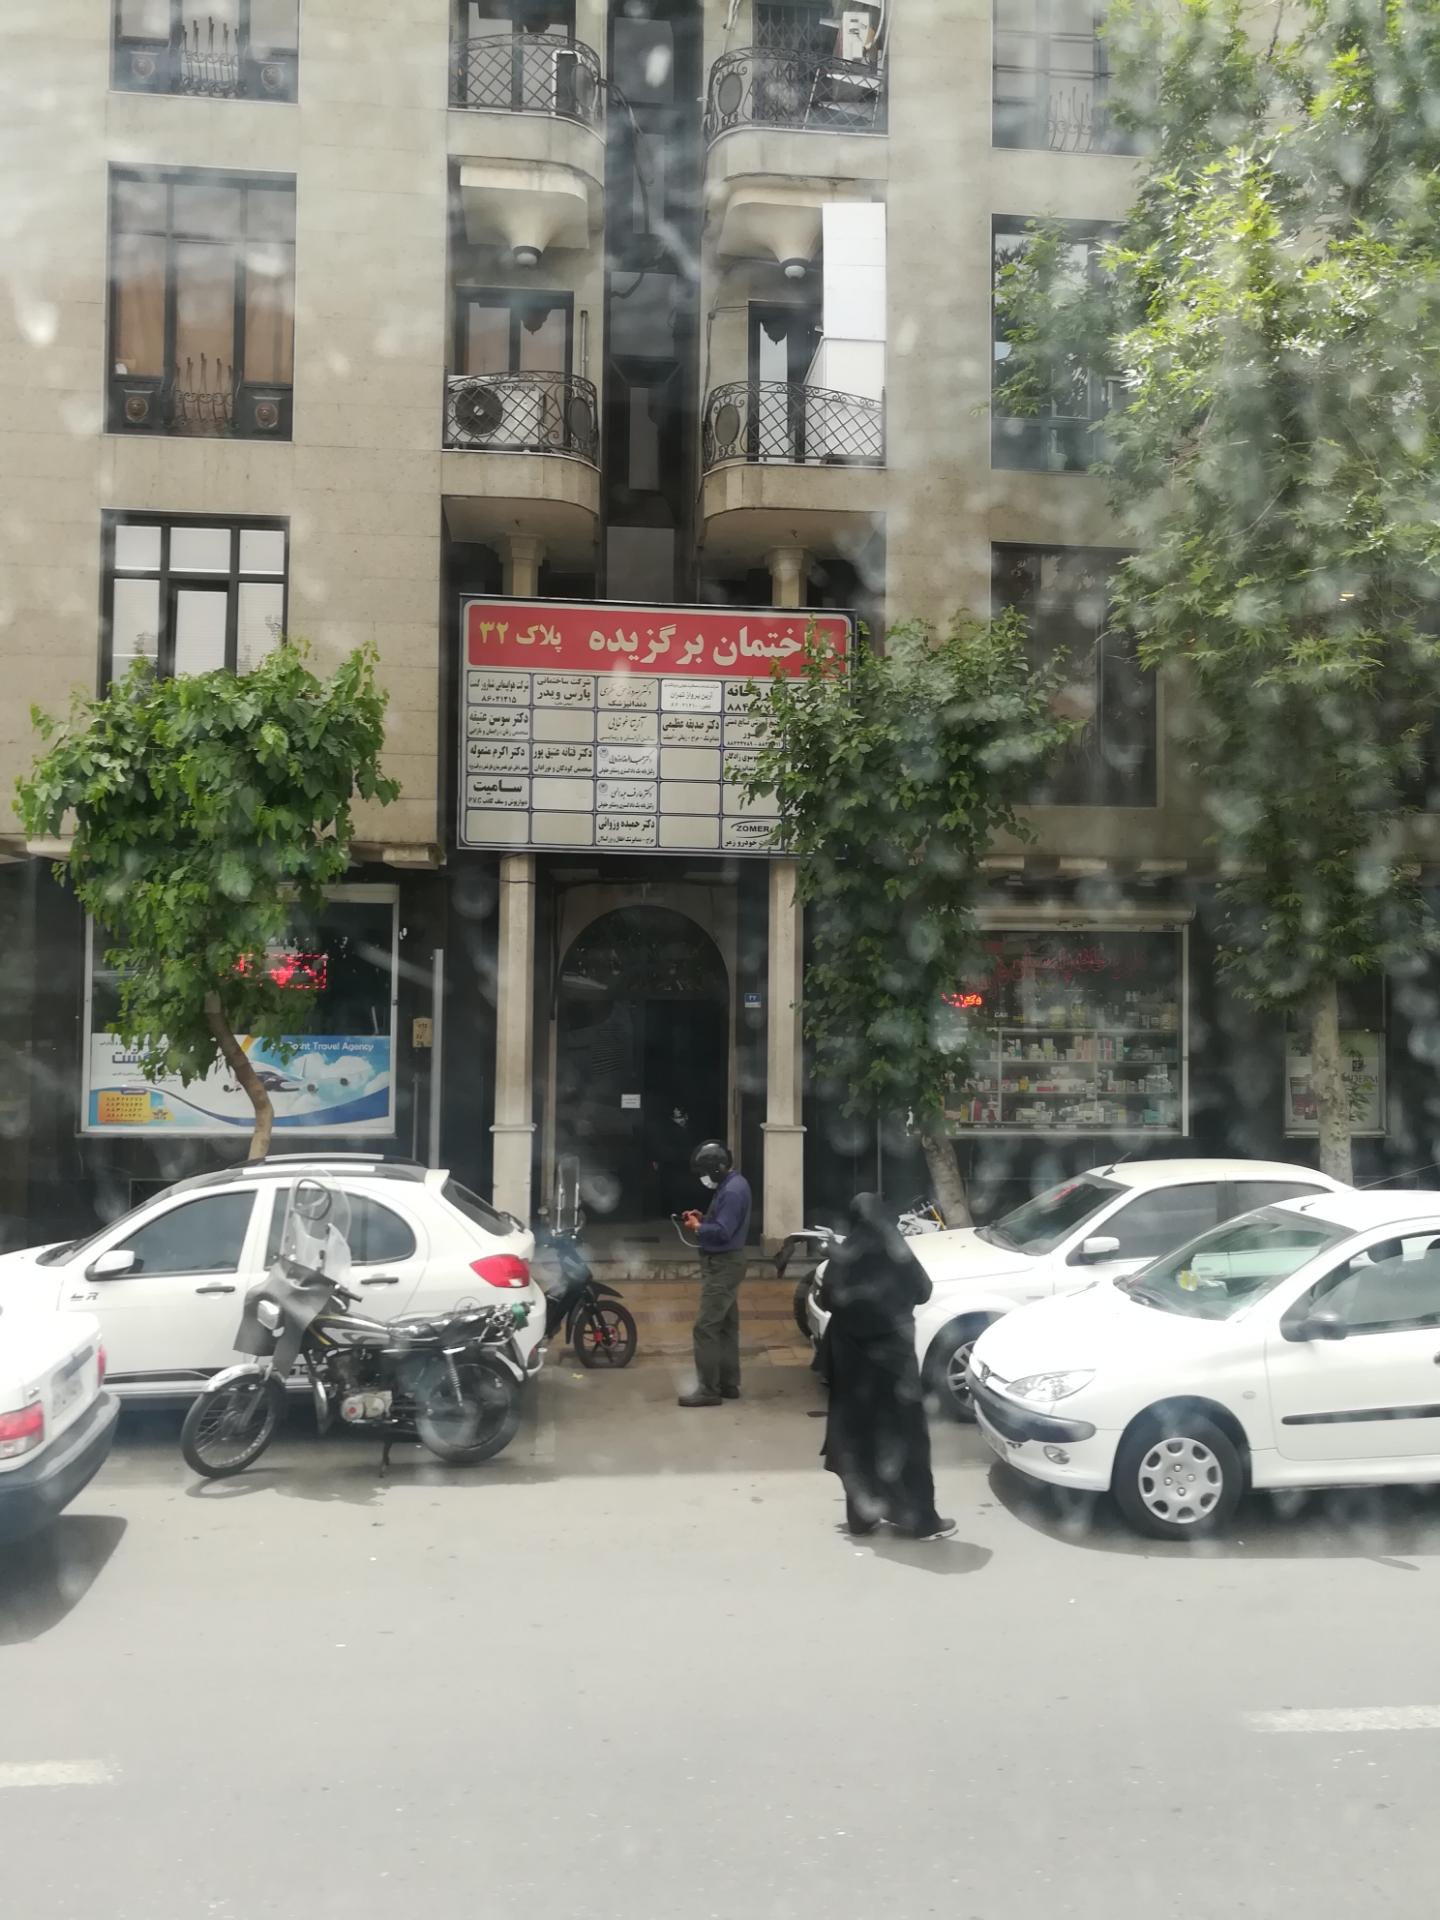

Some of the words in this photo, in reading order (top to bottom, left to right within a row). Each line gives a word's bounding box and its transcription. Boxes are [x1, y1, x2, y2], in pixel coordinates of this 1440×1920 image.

[479, 621, 508, 645] ۳۲
[515, 625, 562, 653] پلاک
[588, 624, 703, 665] برگزیده
[571, 677, 591, 687] شرکت
[512, 711, 529, 727] دکتر
[706, 719, 720, 733] دکتر
[511, 745, 526, 760] دکتر
[577, 747, 593, 761] دکتر
[639, 818, 655, 832] دکتر
[736, 825, 770, 833] ZOMER
[313, 1041, 340, 1052] Travel
[342, 1041, 374, 1054] Agency
